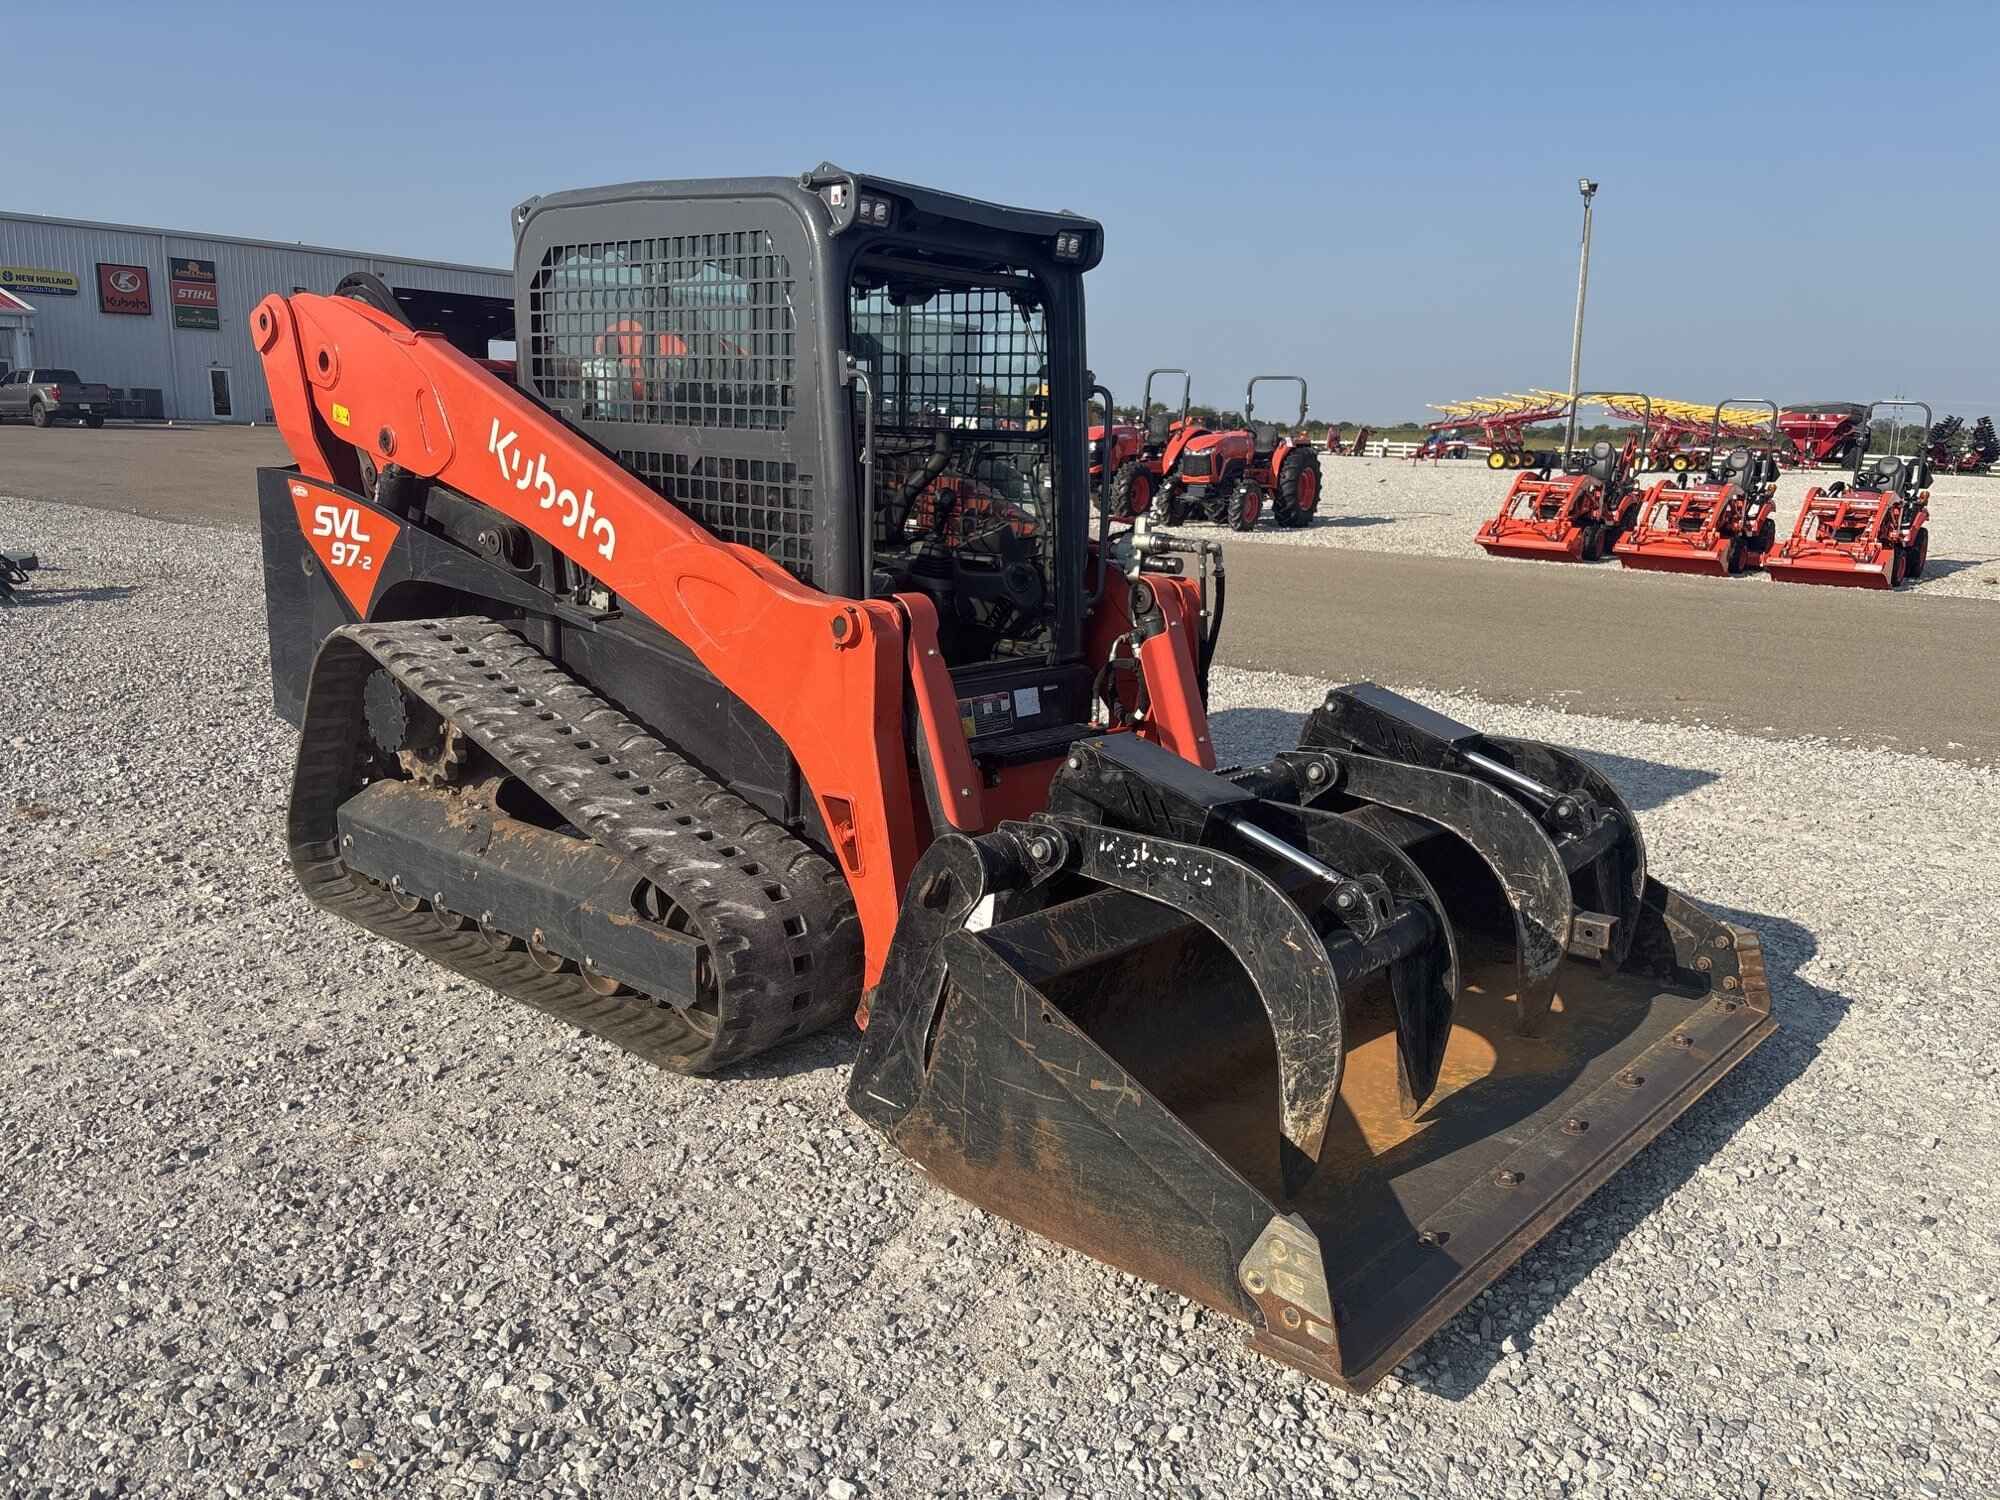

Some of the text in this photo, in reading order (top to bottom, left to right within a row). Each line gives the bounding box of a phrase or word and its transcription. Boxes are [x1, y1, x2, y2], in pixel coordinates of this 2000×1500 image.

[15, 273, 73, 286] NEW HOLLAND
[106, 296, 148, 309] Kubota
[177, 288, 215, 300] STIHL
[488, 417, 616, 560] Kubota
[312, 505, 370, 542] SVL
[331, 541, 372, 571] 97-2
